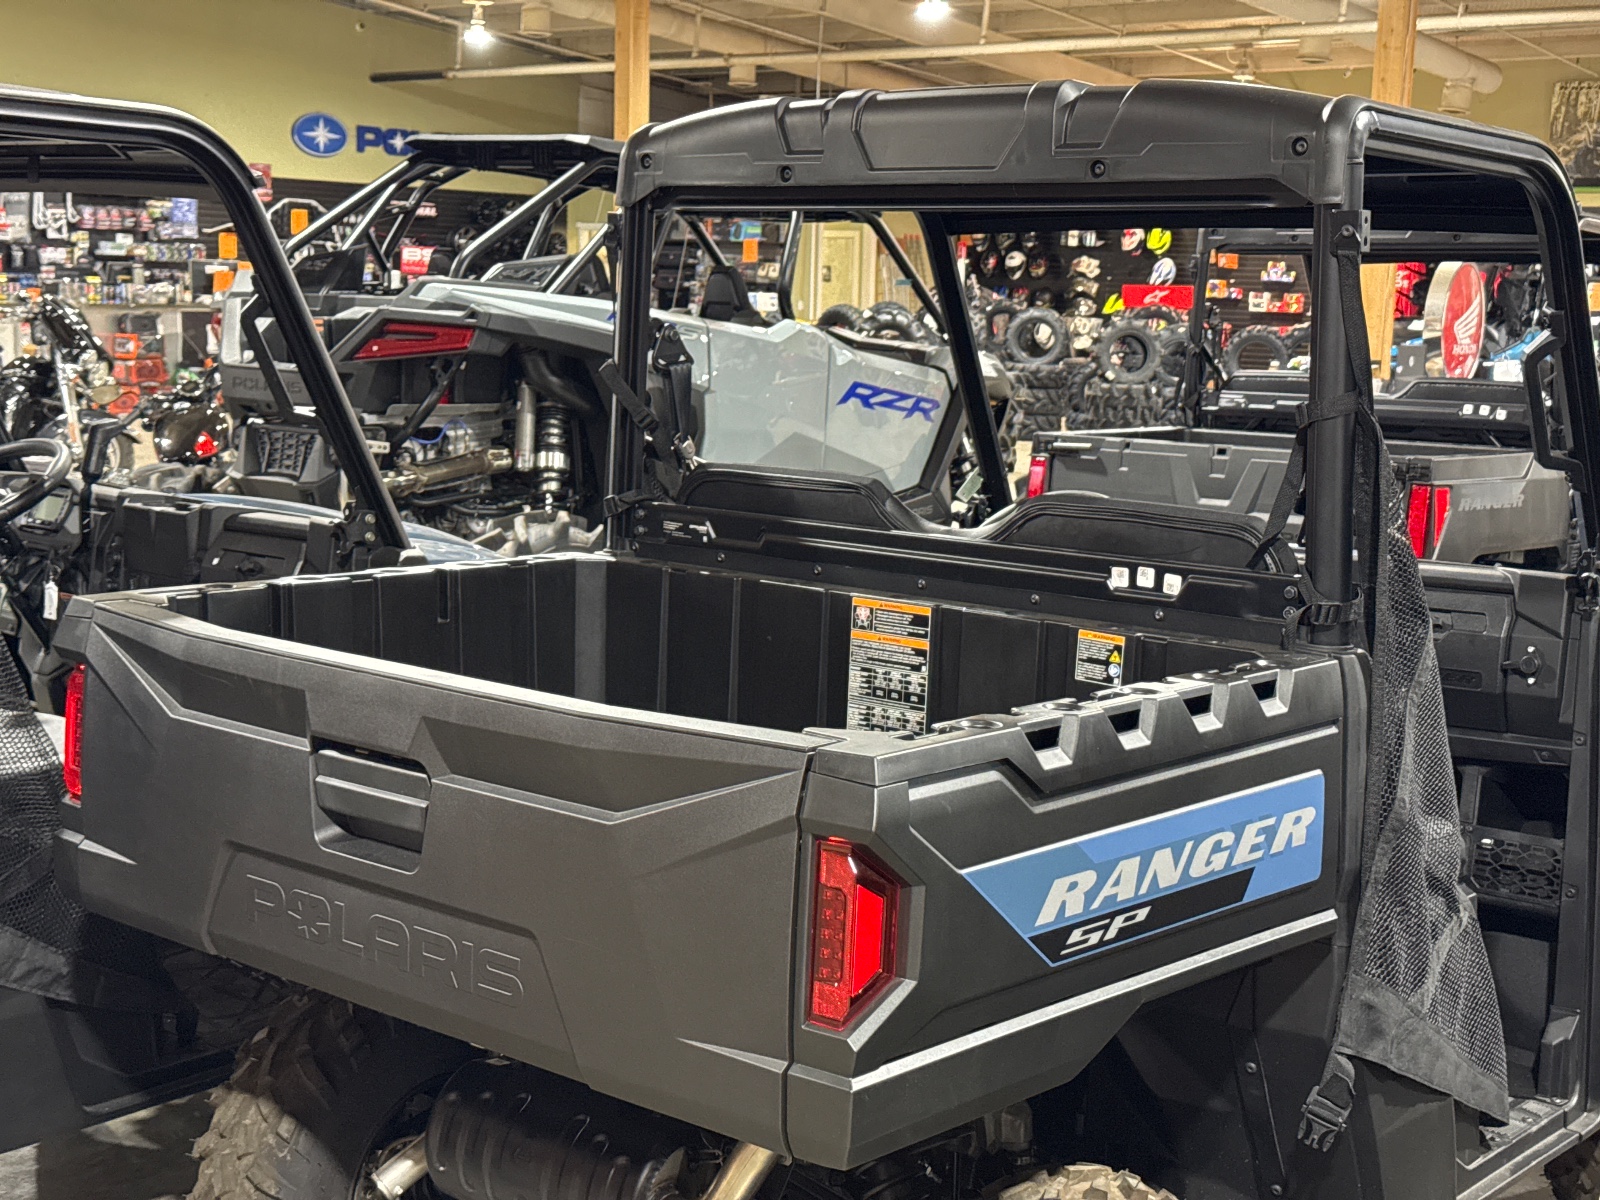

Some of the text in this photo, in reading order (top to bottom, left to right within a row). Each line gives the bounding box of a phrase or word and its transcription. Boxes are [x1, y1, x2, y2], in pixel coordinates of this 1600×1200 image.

[356, 125, 420, 156] PO
[836, 380, 940, 423] RZR
[1457, 494, 1525, 512] RANGER
[1034, 806, 1317, 927] RANGER
[246, 873, 525, 1009] POLARIS
[1060, 905, 1152, 956] SP
